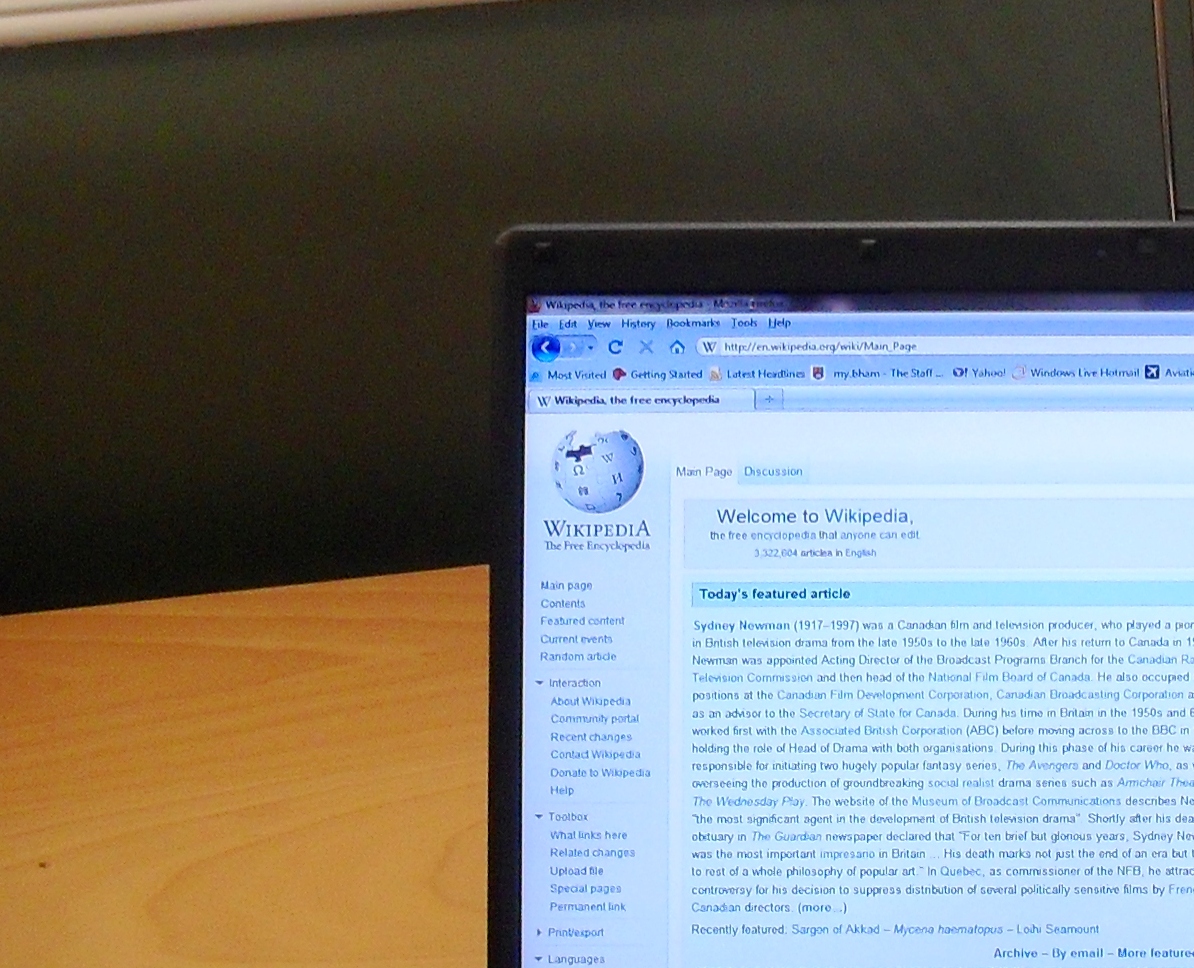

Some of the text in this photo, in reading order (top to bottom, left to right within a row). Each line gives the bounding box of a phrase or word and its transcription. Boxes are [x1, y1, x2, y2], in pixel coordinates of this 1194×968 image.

[531, 317, 792, 331] File Edit View History Bookmarks Tools Help
[547, 370, 607, 381] Most Visited
[630, 369, 703, 382] Getting Started
[726, 369, 806, 379] Latest Headlines
[971, 368, 1006, 379] Yahoo!
[1030, 367, 1140, 378] Windows Live Hotmail
[609, 395, 627, 405] the
[629, 395, 652, 405] free
[654, 394, 720, 407] encyclopedia
[676, 466, 733, 480] Main Page
[744, 465, 803, 477] Discussion
[716, 508, 797, 524] Welcome
[802, 509, 819, 524] to
[543, 519, 651, 538] WIKIPEDIA
[709, 530, 920, 542] the free encyclopedia that anyone can edit
[544, 540, 651, 553] The Free Encyclopedia
[698, 587, 851, 603] Today's featured article
[540, 598, 586, 609] Contents
[693, 620, 736, 634] Sydney
[739, 619, 791, 631] Newman
[862, 622, 884, 631] was
[887, 622, 894, 631] a
[897, 619, 947, 631] Canadian
[950, 619, 970, 630] film
[972, 619, 992, 630] and
[995, 619, 1045, 630] television
[1101, 619, 1123, 630] who
[1126, 619, 1162, 633] played
[1164, 622, 1171, 630] a
[540, 651, 617, 662] Random article
[550, 696, 631, 707] About Wikipedia
[550, 785, 575, 797] Help
[548, 811, 589, 822] Toolbox
